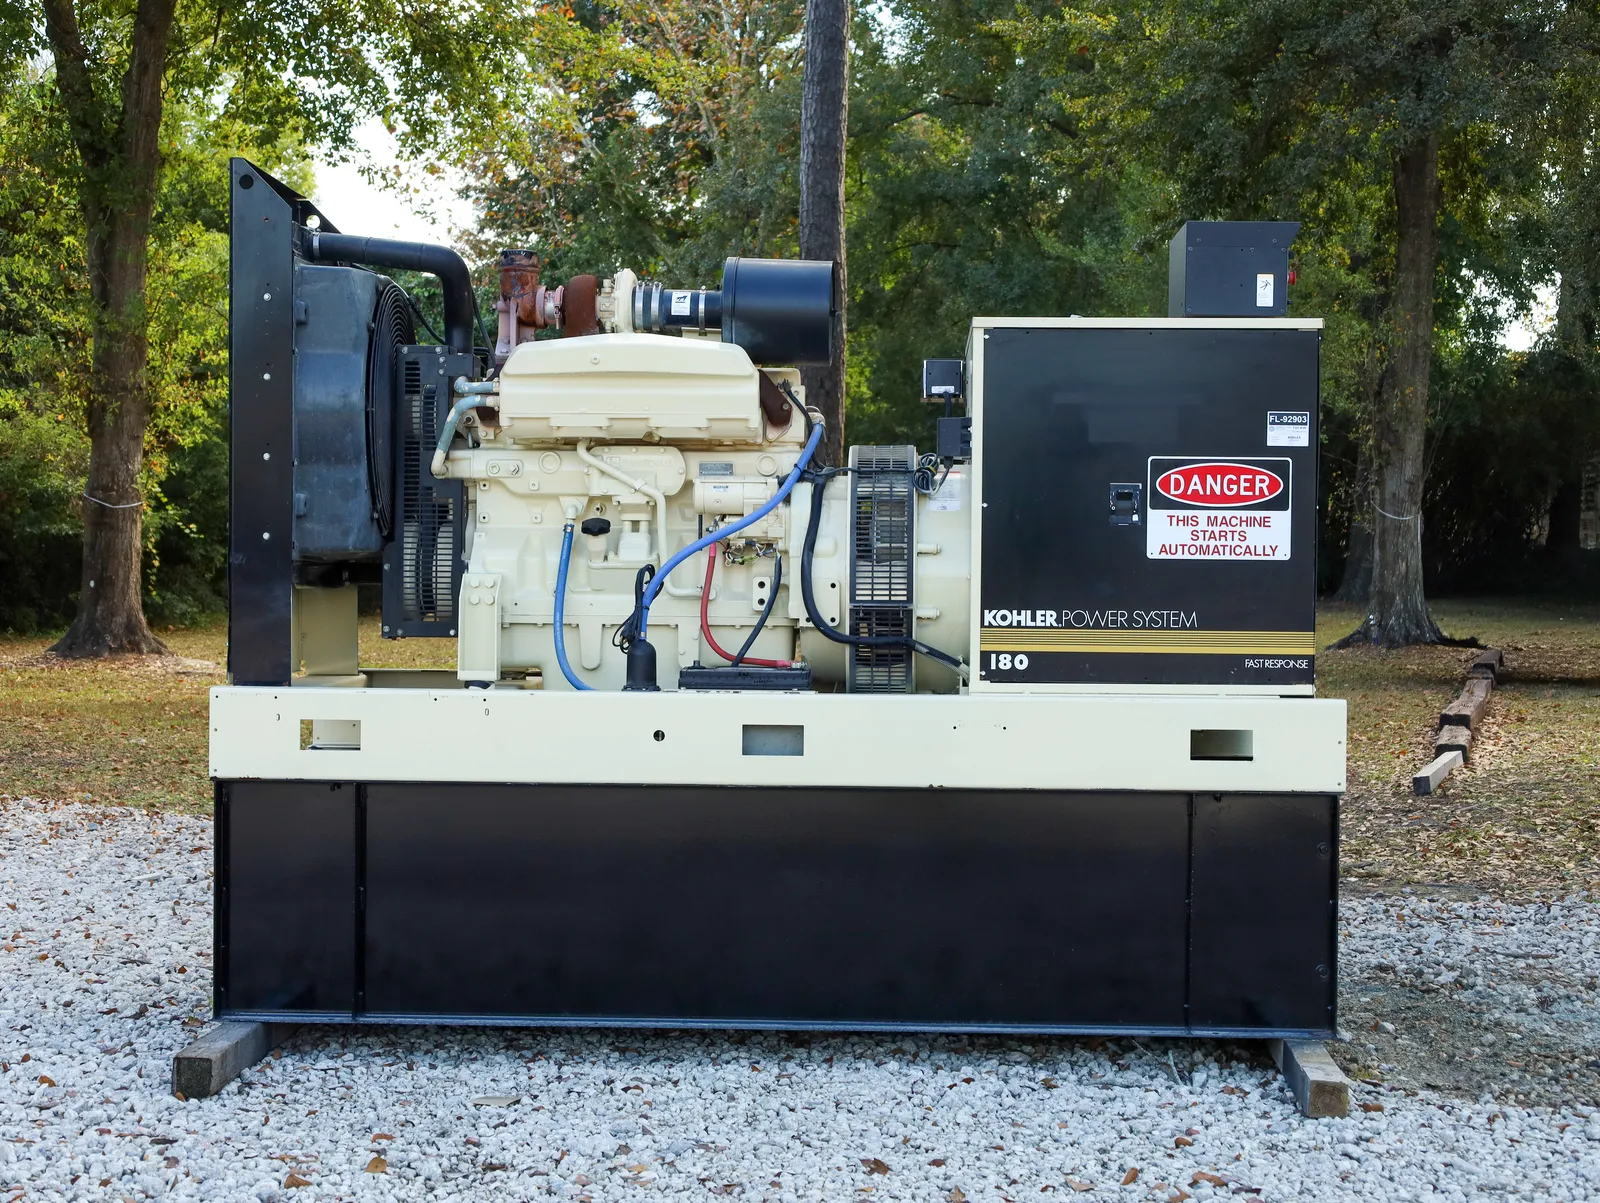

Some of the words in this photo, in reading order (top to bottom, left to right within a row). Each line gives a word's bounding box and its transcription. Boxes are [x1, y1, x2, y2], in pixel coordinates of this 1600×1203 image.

[1269, 415, 1307, 423] FL-92903
[1169, 474, 1270, 496] DANGER
[1167, 515, 1199, 527] THIS
[1206, 516, 1271, 528] MACHINE
[1190, 530, 1247, 542] STARTS
[1158, 544, 1278, 557] AUTOMATICALLY
[983, 609, 1058, 627] KOHLER
[1062, 610, 1128, 628] POWER
[1132, 610, 1198, 628] SYSTEM
[990, 653, 1029, 671] 180
[1245, 659, 1265, 668] FAST
[1265, 659, 1309, 669] RESPONSE
